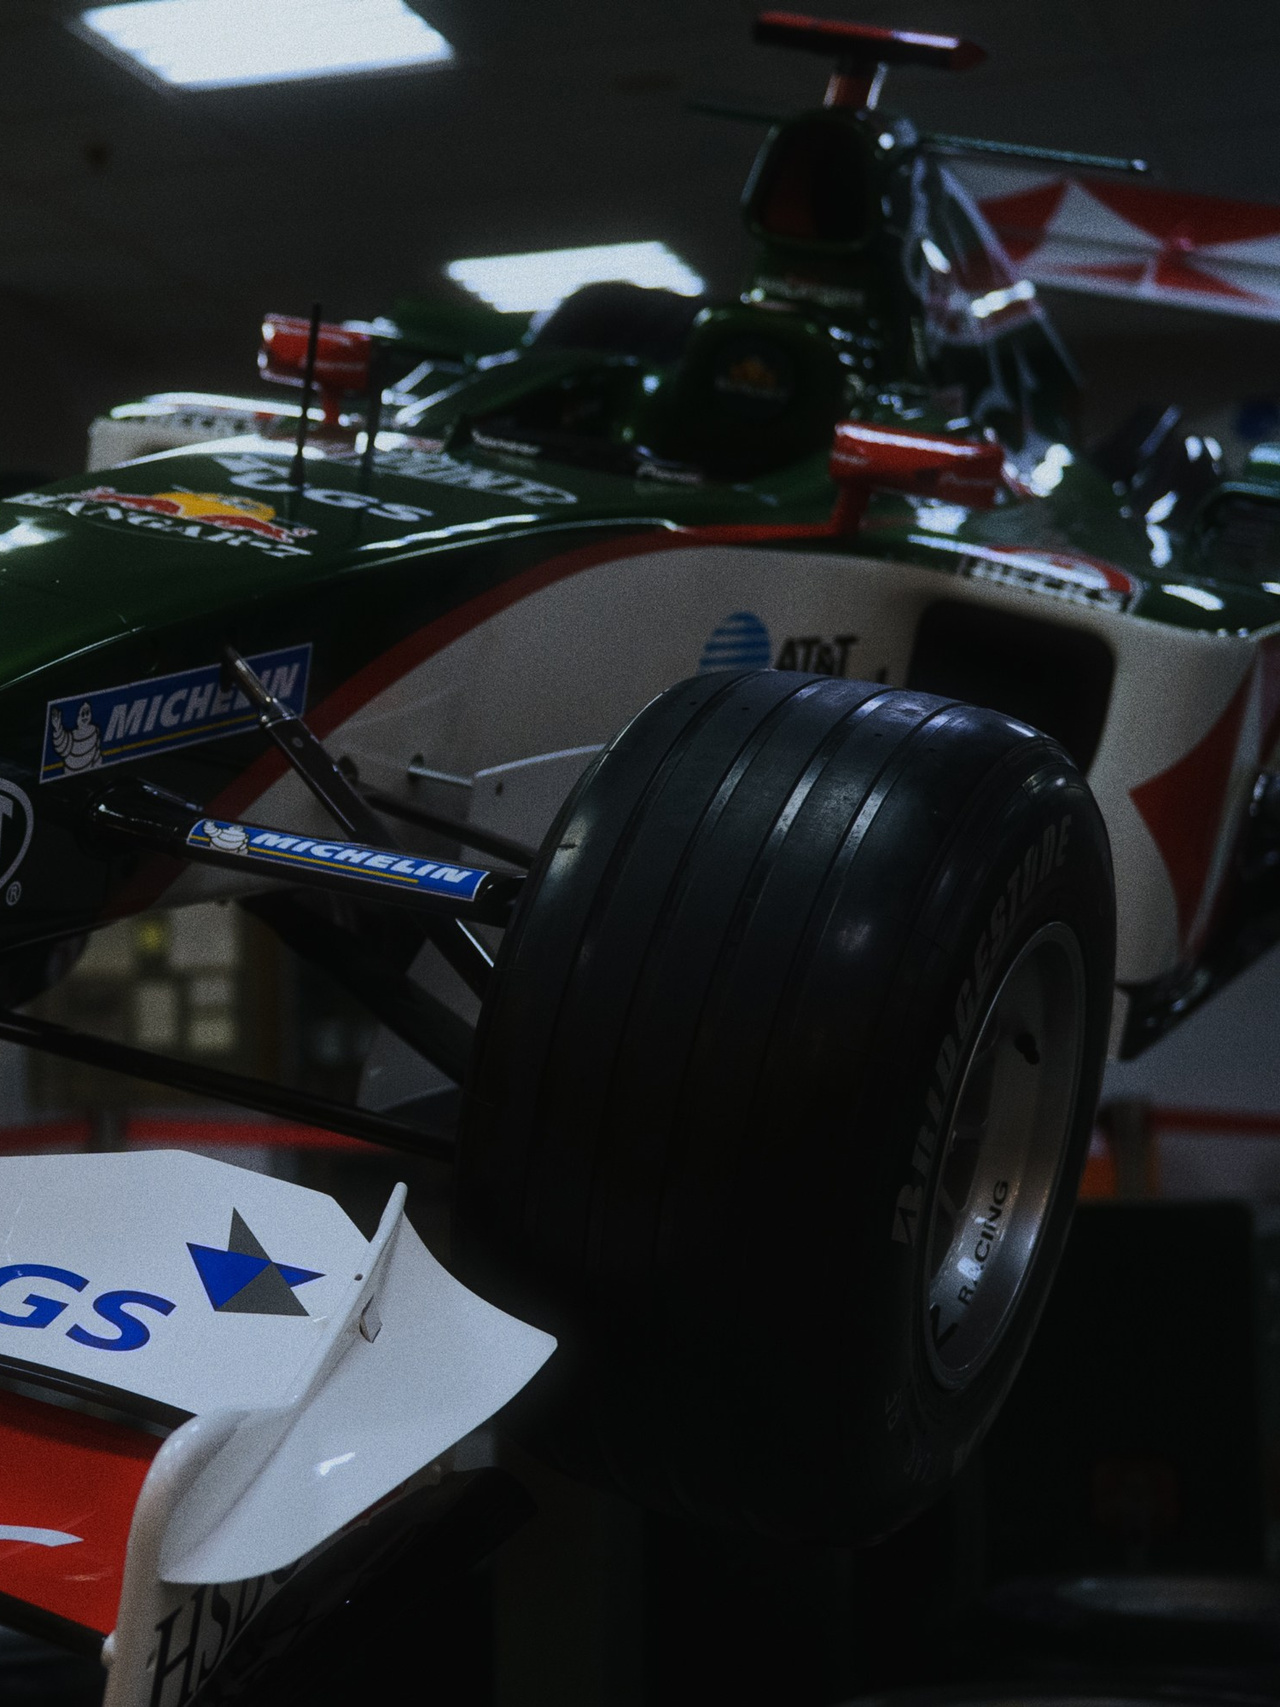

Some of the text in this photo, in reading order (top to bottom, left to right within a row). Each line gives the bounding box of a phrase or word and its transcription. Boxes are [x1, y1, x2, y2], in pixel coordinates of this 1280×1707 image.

[775, 632, 859, 678] AT&T
[250, 832, 472, 884] MICHELIN
[891, 813, 1073, 1248] BRIDGESTONE
